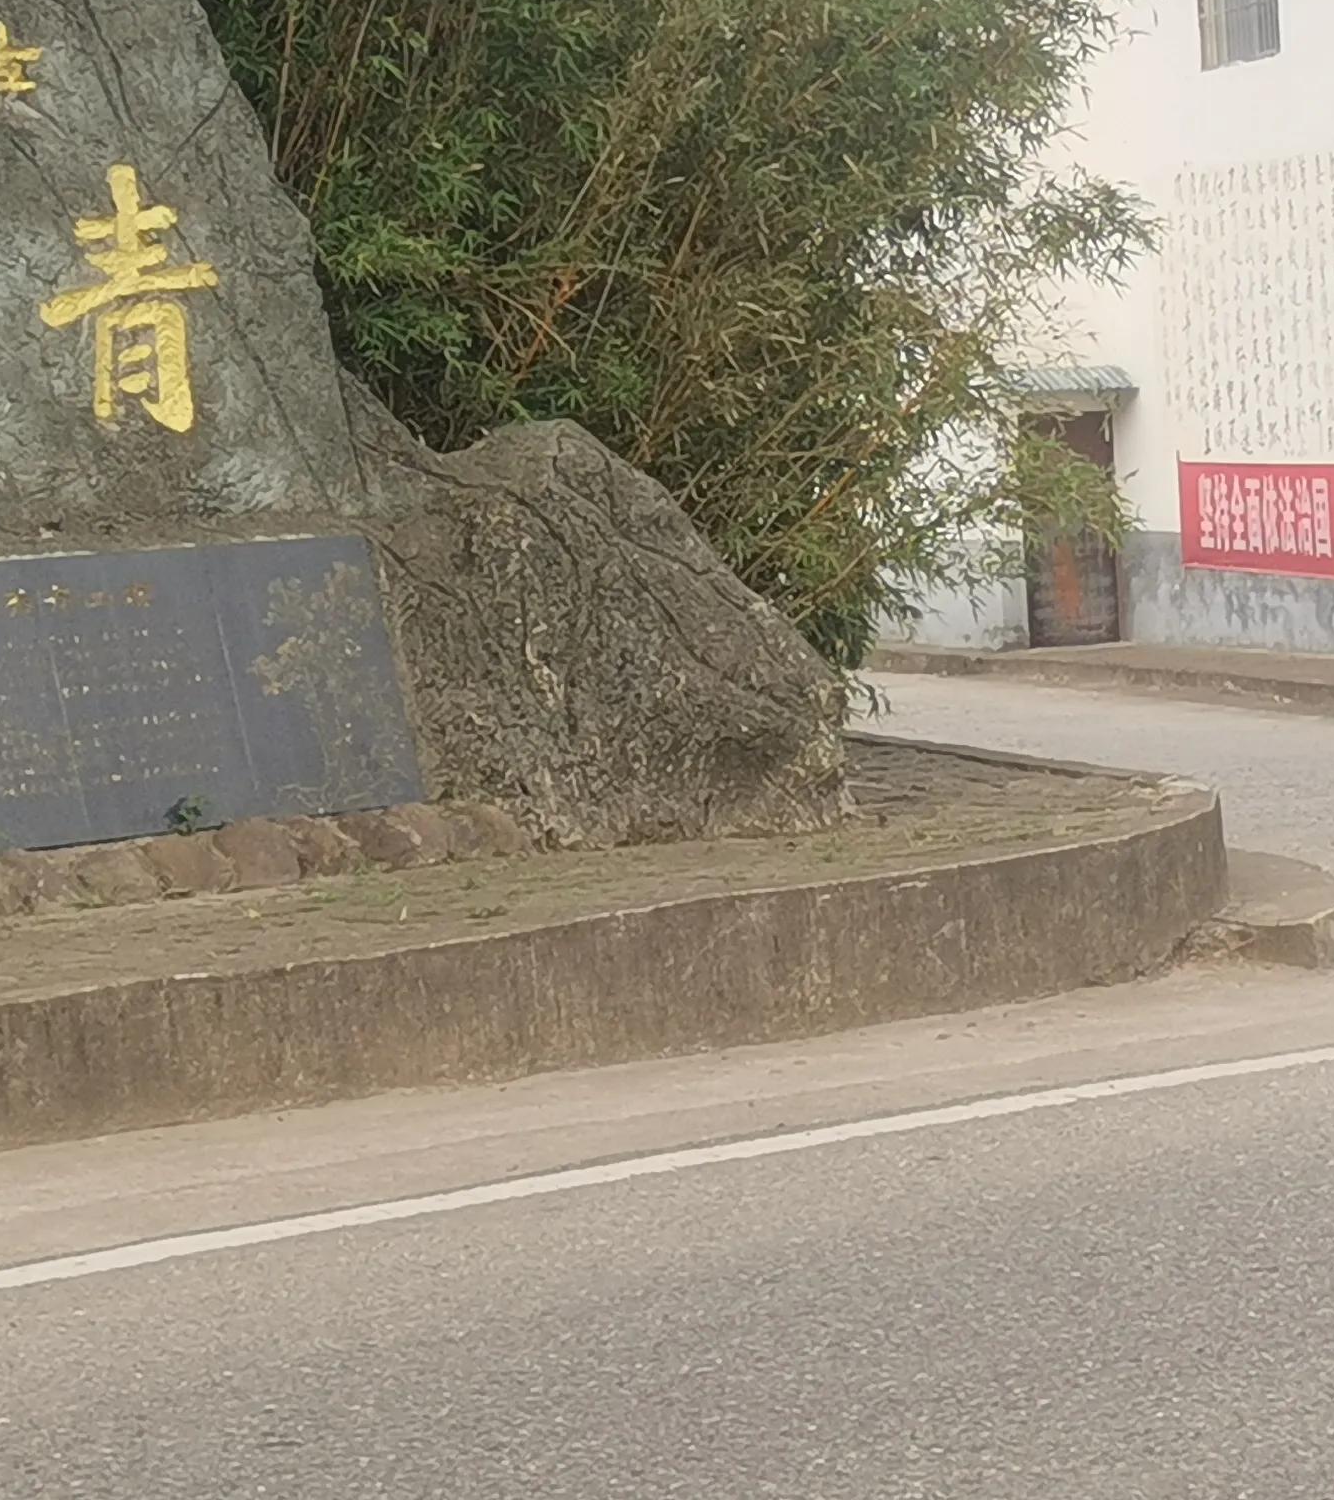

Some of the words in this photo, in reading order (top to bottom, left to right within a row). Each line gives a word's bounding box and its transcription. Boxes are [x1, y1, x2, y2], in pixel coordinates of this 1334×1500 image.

[1198, 473, 1332, 559] 坚持全面依法治国
